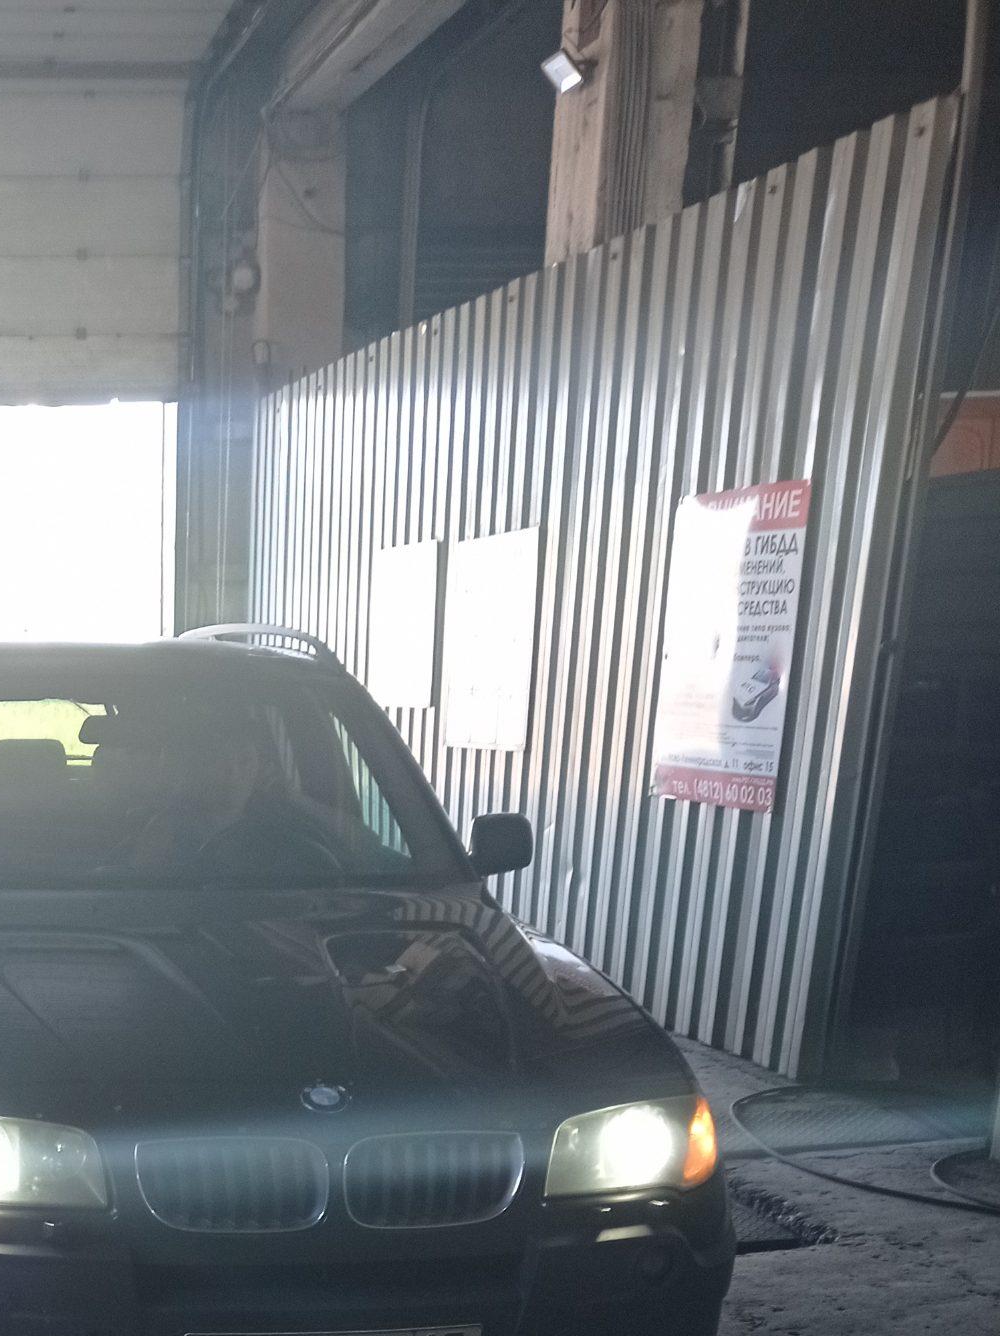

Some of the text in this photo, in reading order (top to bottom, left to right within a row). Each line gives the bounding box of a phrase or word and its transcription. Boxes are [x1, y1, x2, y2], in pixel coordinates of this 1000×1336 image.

[754, 532, 799, 556] ГИБДД
[739, 578, 795, 597] СТРУКЦИЮ
[737, 599, 788, 616] СРЕДСТВА
[725, 783, 739, 800] 60
[741, 785, 756, 804] 02
[757, 787, 773, 807] 03
